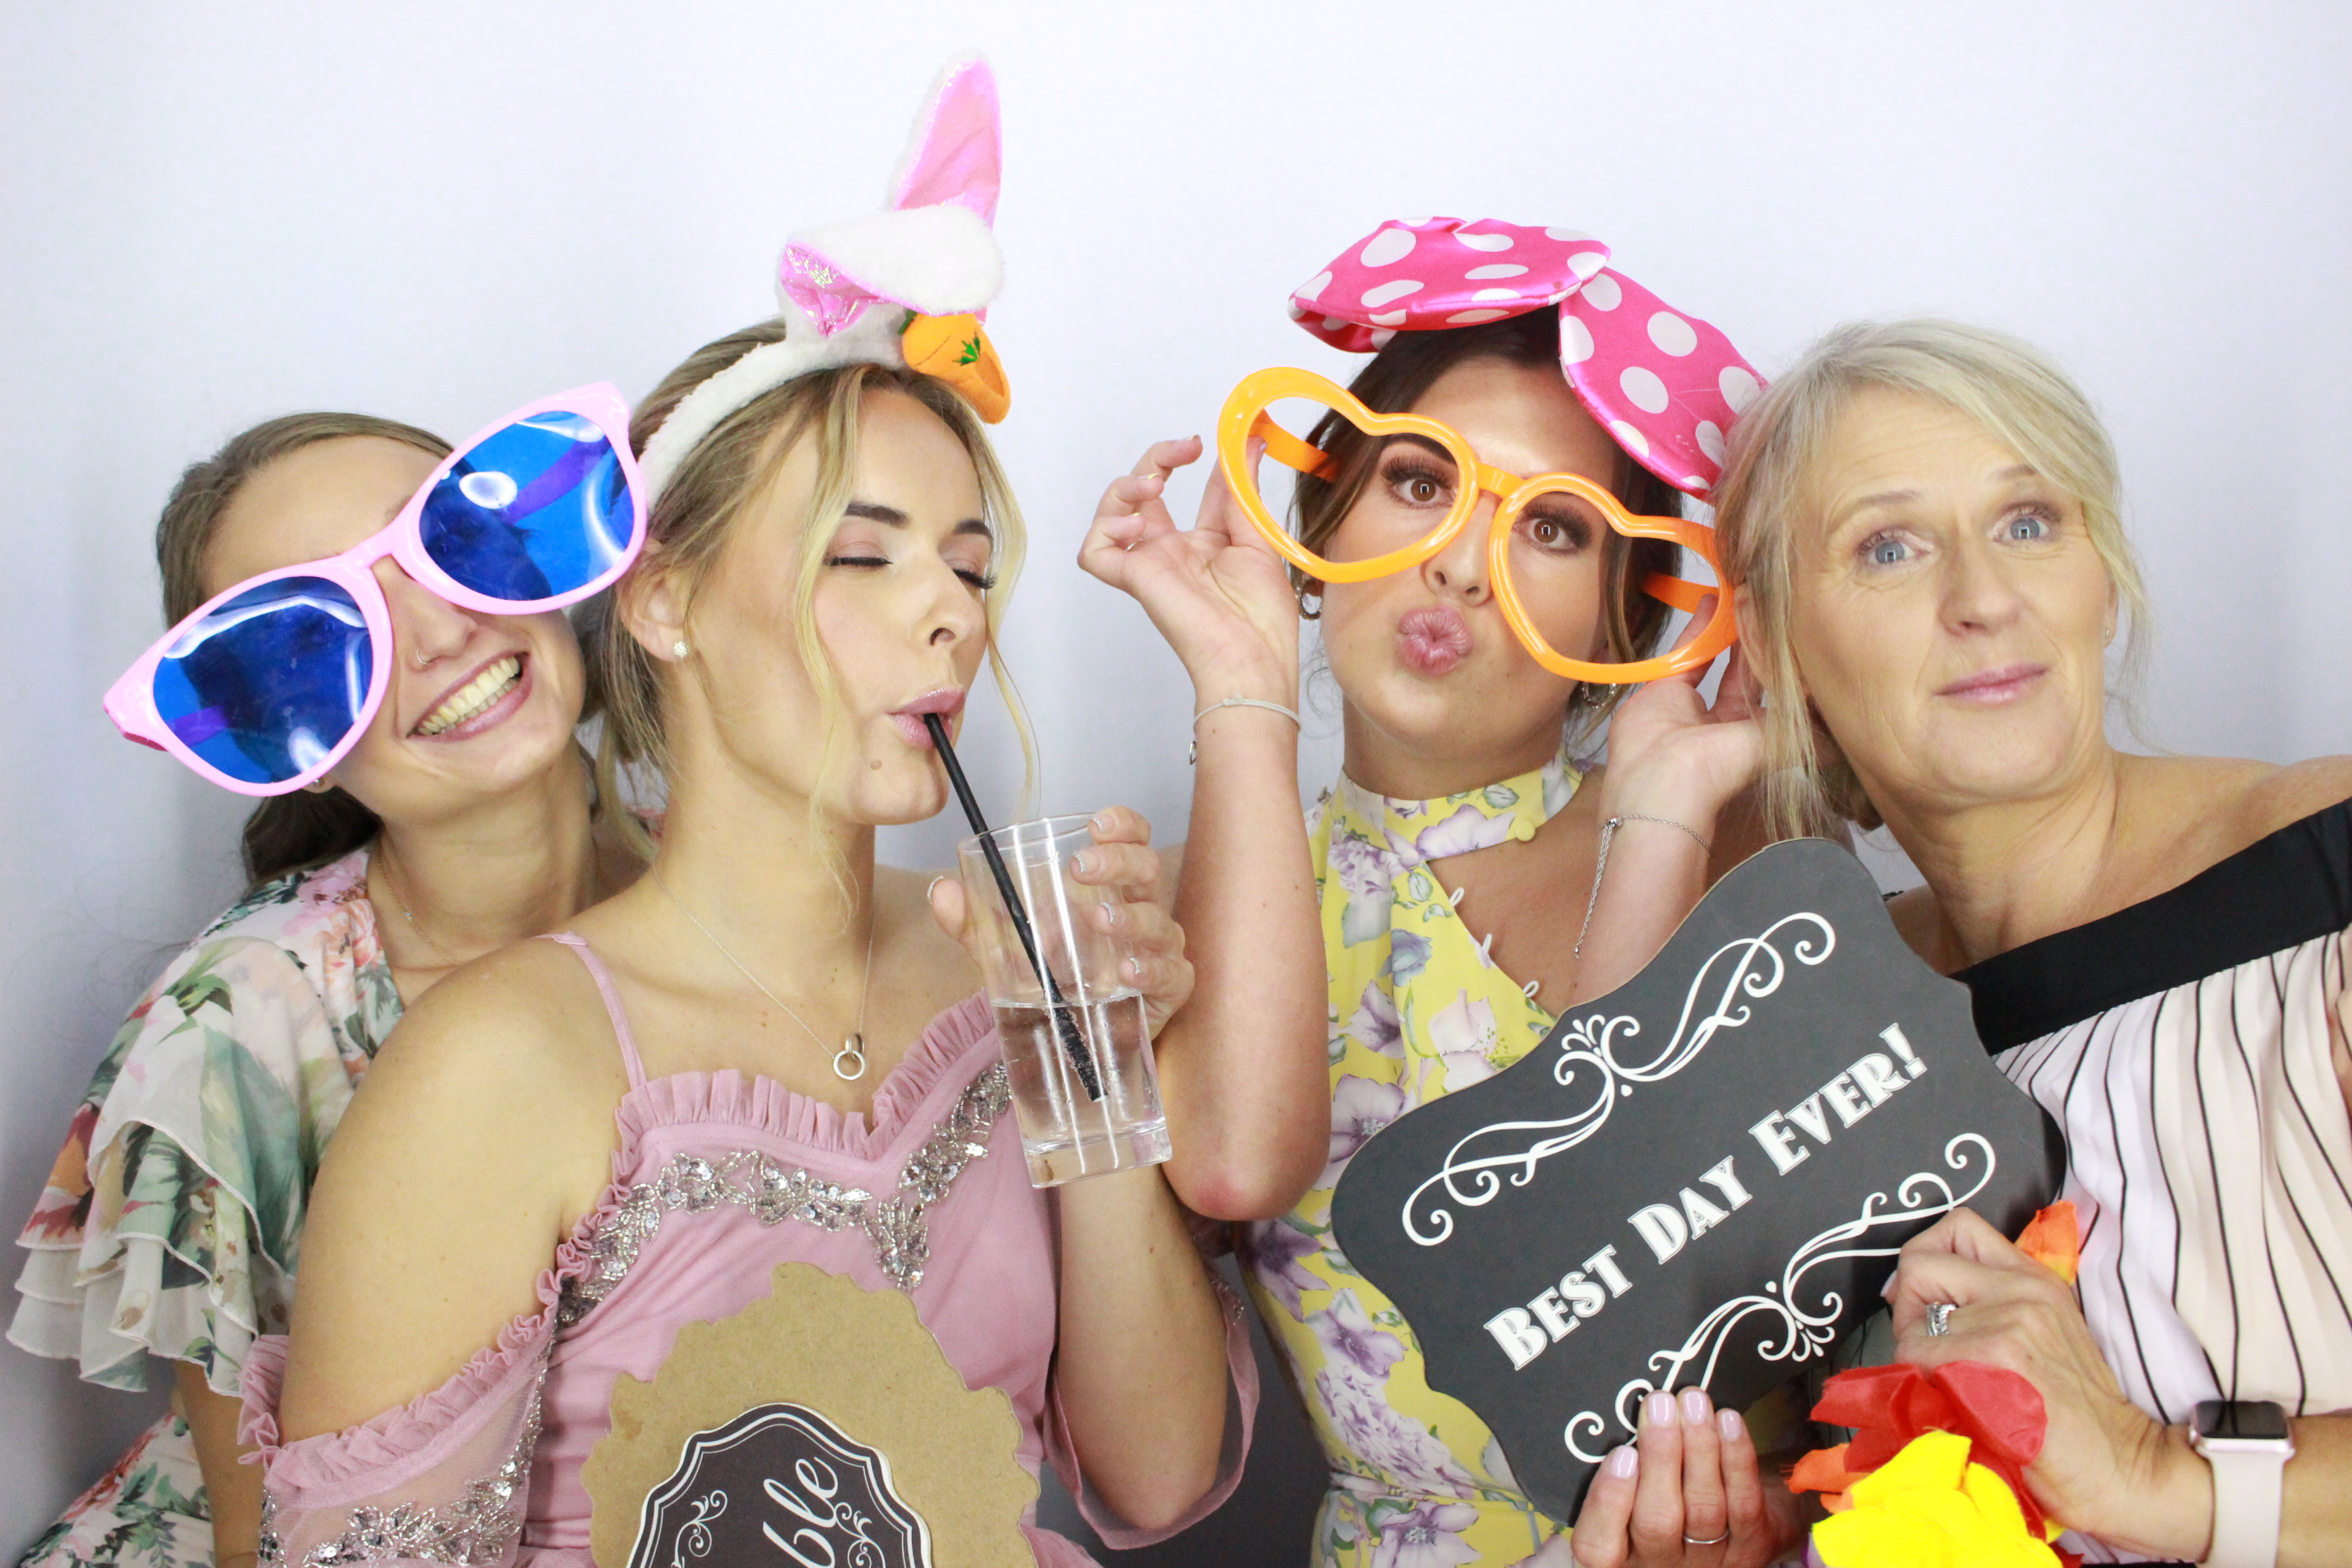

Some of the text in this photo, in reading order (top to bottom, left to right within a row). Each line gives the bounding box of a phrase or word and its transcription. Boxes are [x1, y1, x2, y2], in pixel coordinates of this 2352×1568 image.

[1484, 1022, 1928, 1371] BEST DAY EVER!
